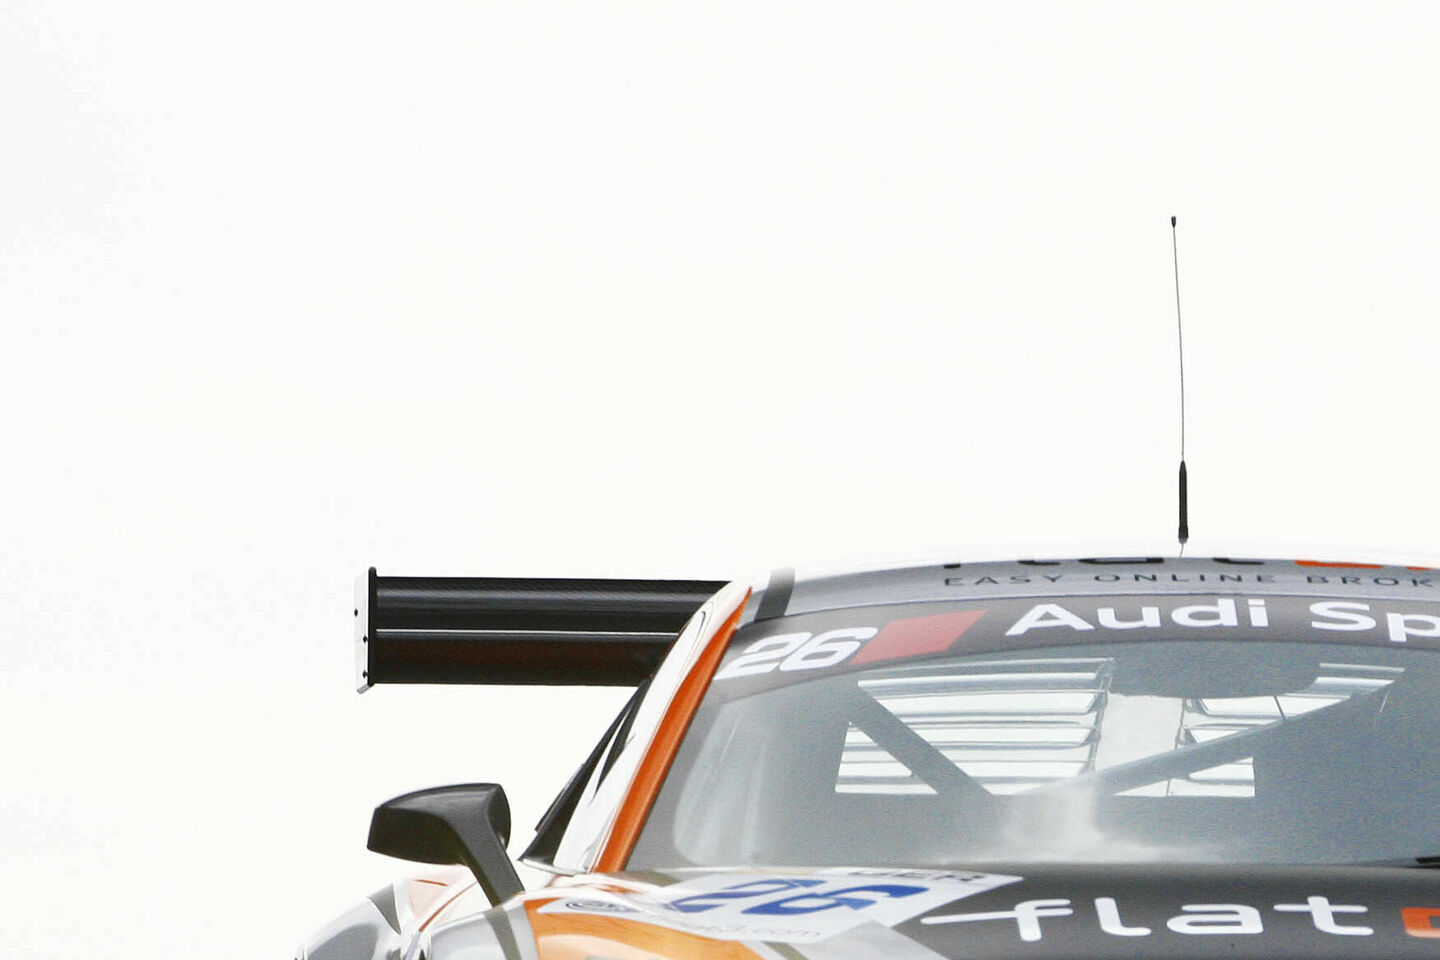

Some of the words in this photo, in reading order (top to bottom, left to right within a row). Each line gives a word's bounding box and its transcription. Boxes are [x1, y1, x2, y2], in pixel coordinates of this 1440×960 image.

[944, 573, 1062, 587] EASY
[1094, 573, 1276, 584] ONLINE
[713, 626, 879, 681] 26
[1005, 598, 1268, 636] Audi
